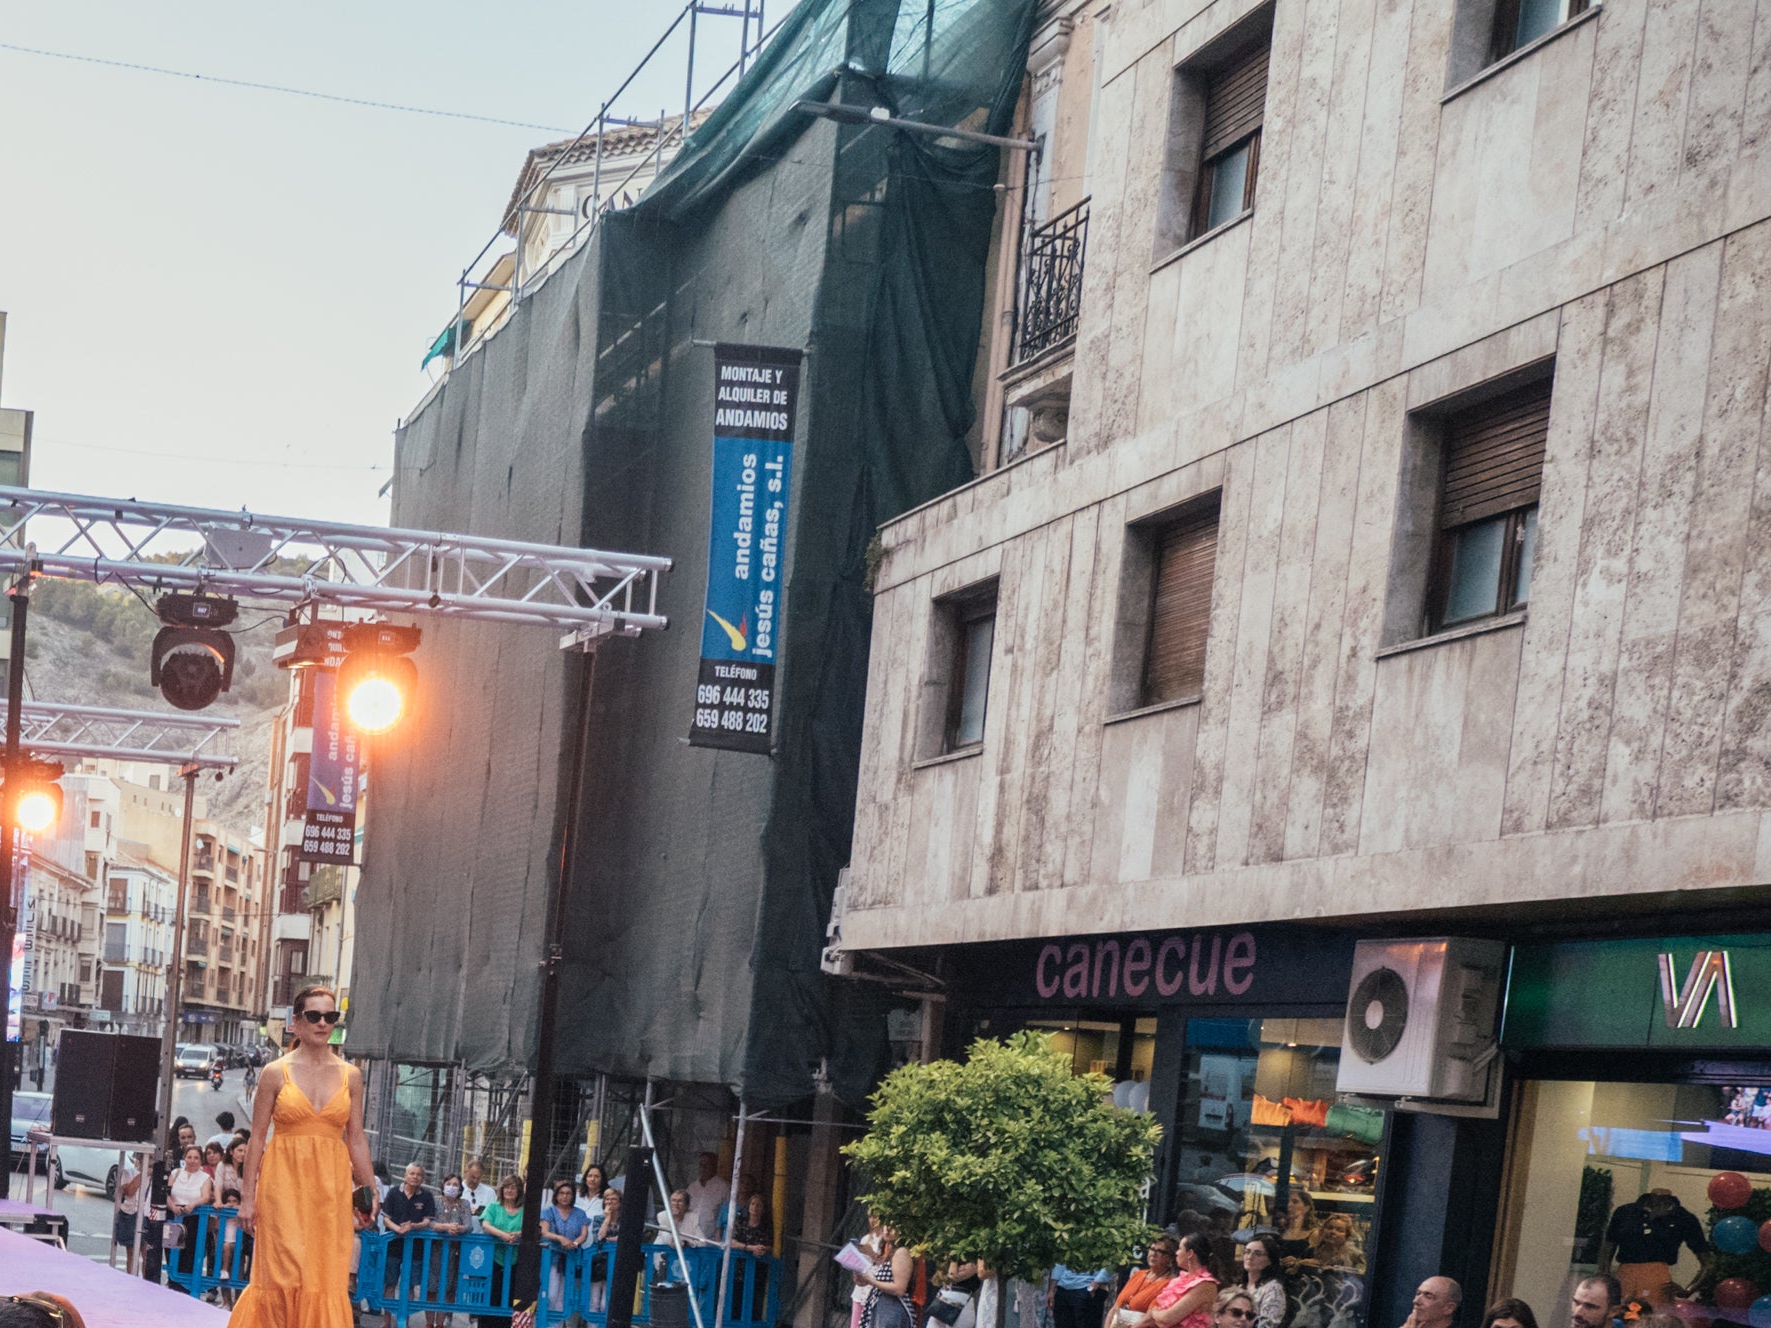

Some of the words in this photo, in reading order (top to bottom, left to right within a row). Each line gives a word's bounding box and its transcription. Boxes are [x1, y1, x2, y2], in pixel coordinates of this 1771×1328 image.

[721, 365, 772, 383] MONTAJE
[775, 370, 783, 384] Y
[718, 386, 770, 404] ALQUILER
[773, 390, 788, 405] DE
[715, 408, 788, 430] ANDAMIOS
[765, 455, 783, 493] s.l.
[734, 453, 757, 580] andamios
[760, 501, 783, 582] cañas,
[752, 589, 773, 658] jesús
[715, 664, 757, 680] TELÉFONO
[697, 684, 721, 704] 696
[722, 686, 745, 707] 444
[747, 688, 769, 709] 335
[696, 708, 719, 728] 659
[721, 710, 743, 731] 488
[745, 712, 767, 733] 202
[339, 767, 354, 809] jesús
[316, 812, 344, 824] TELÉFONO
[305, 824, 320, 838] 696
[321, 826, 336, 839] 444
[336, 827, 351, 841] 335
[304, 839, 319, 853] 659
[319, 841, 334, 854] 488
[335, 842, 350, 856] 202
[1036, 932, 1257, 999] canecue
[1658, 950, 1738, 1029] VA
